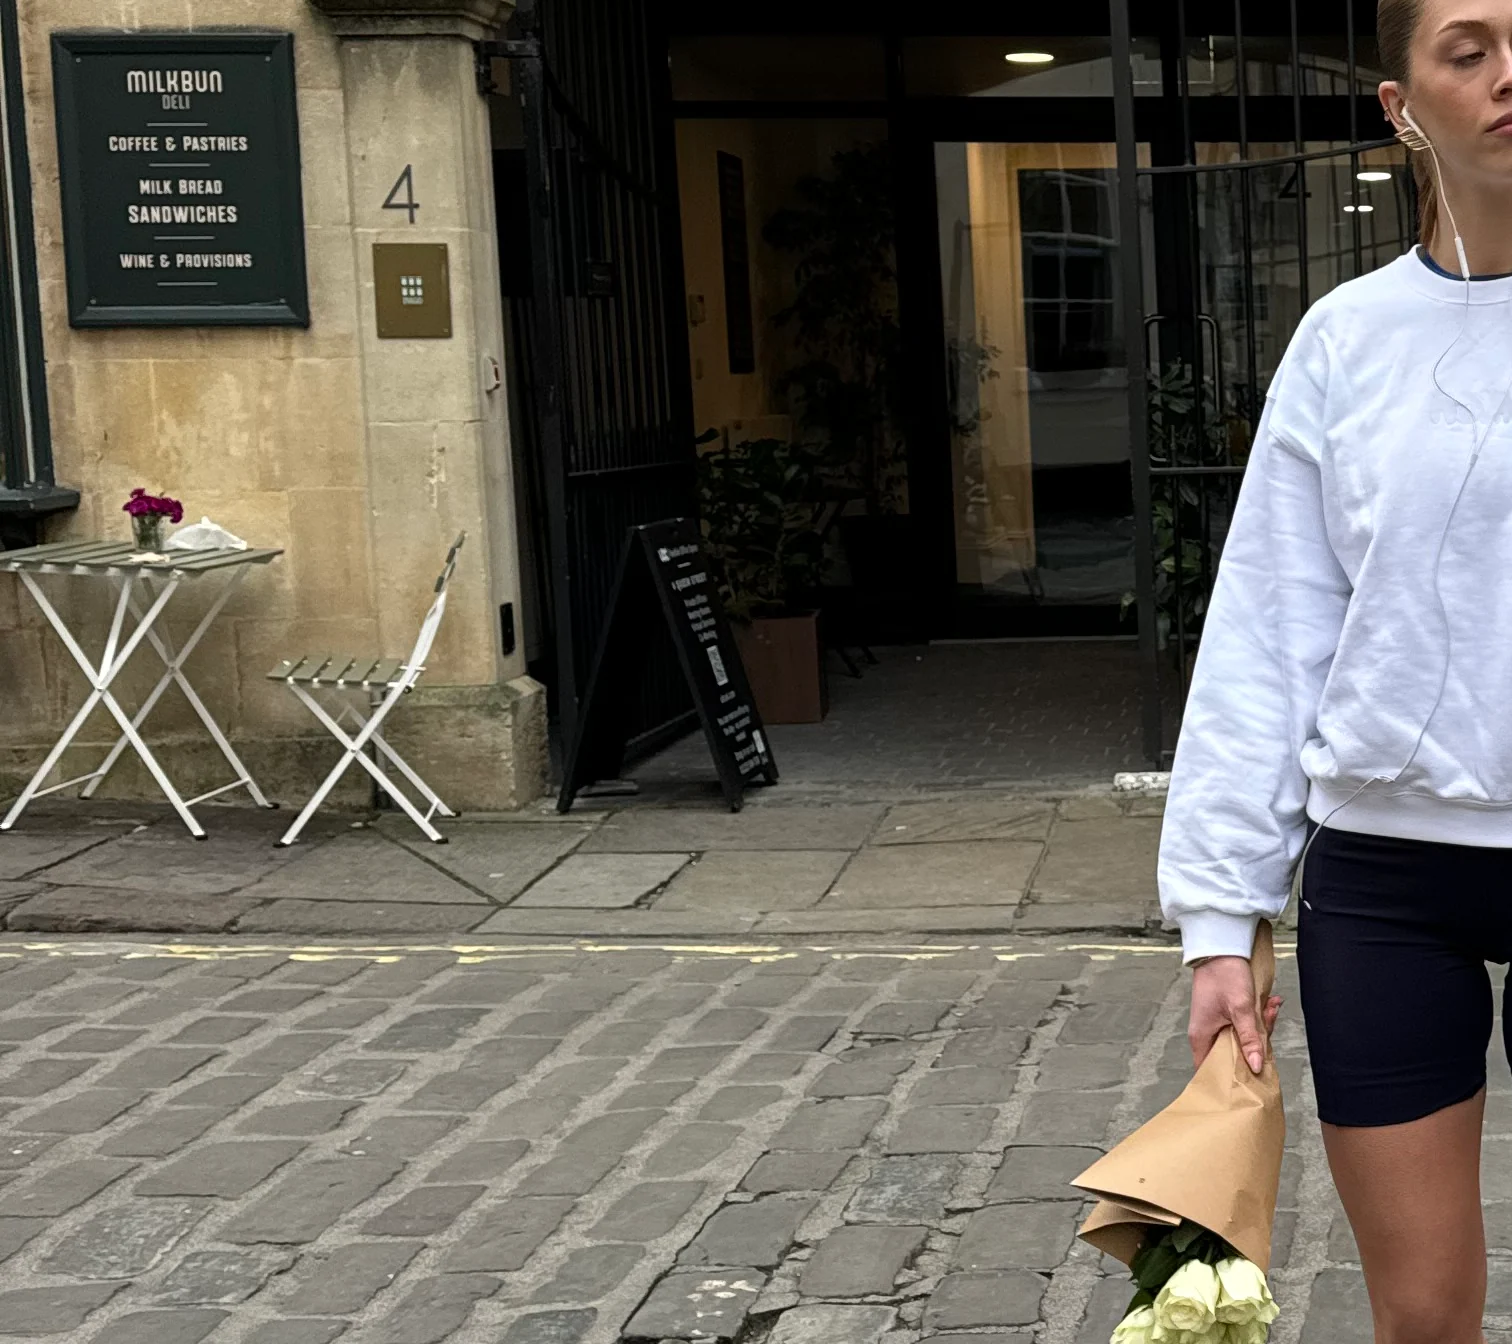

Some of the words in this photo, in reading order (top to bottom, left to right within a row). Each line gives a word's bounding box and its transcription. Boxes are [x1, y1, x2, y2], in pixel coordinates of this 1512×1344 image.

[127, 71, 222, 92] MILKBUN
[162, 94, 190, 109] DELI
[109, 136, 158, 151] COFFEE
[166, 137, 176, 151] &
[183, 136, 247, 151] PASTRIES
[140, 180, 172, 194] MILK
[179, 180, 222, 194] BREAD
[381, 163, 420, 224] 4
[129, 205, 237, 223] SANDWICHES
[120, 254, 154, 268] WINE
[160, 254, 170, 267] &
[176, 254, 252, 267] PROVISIONS
